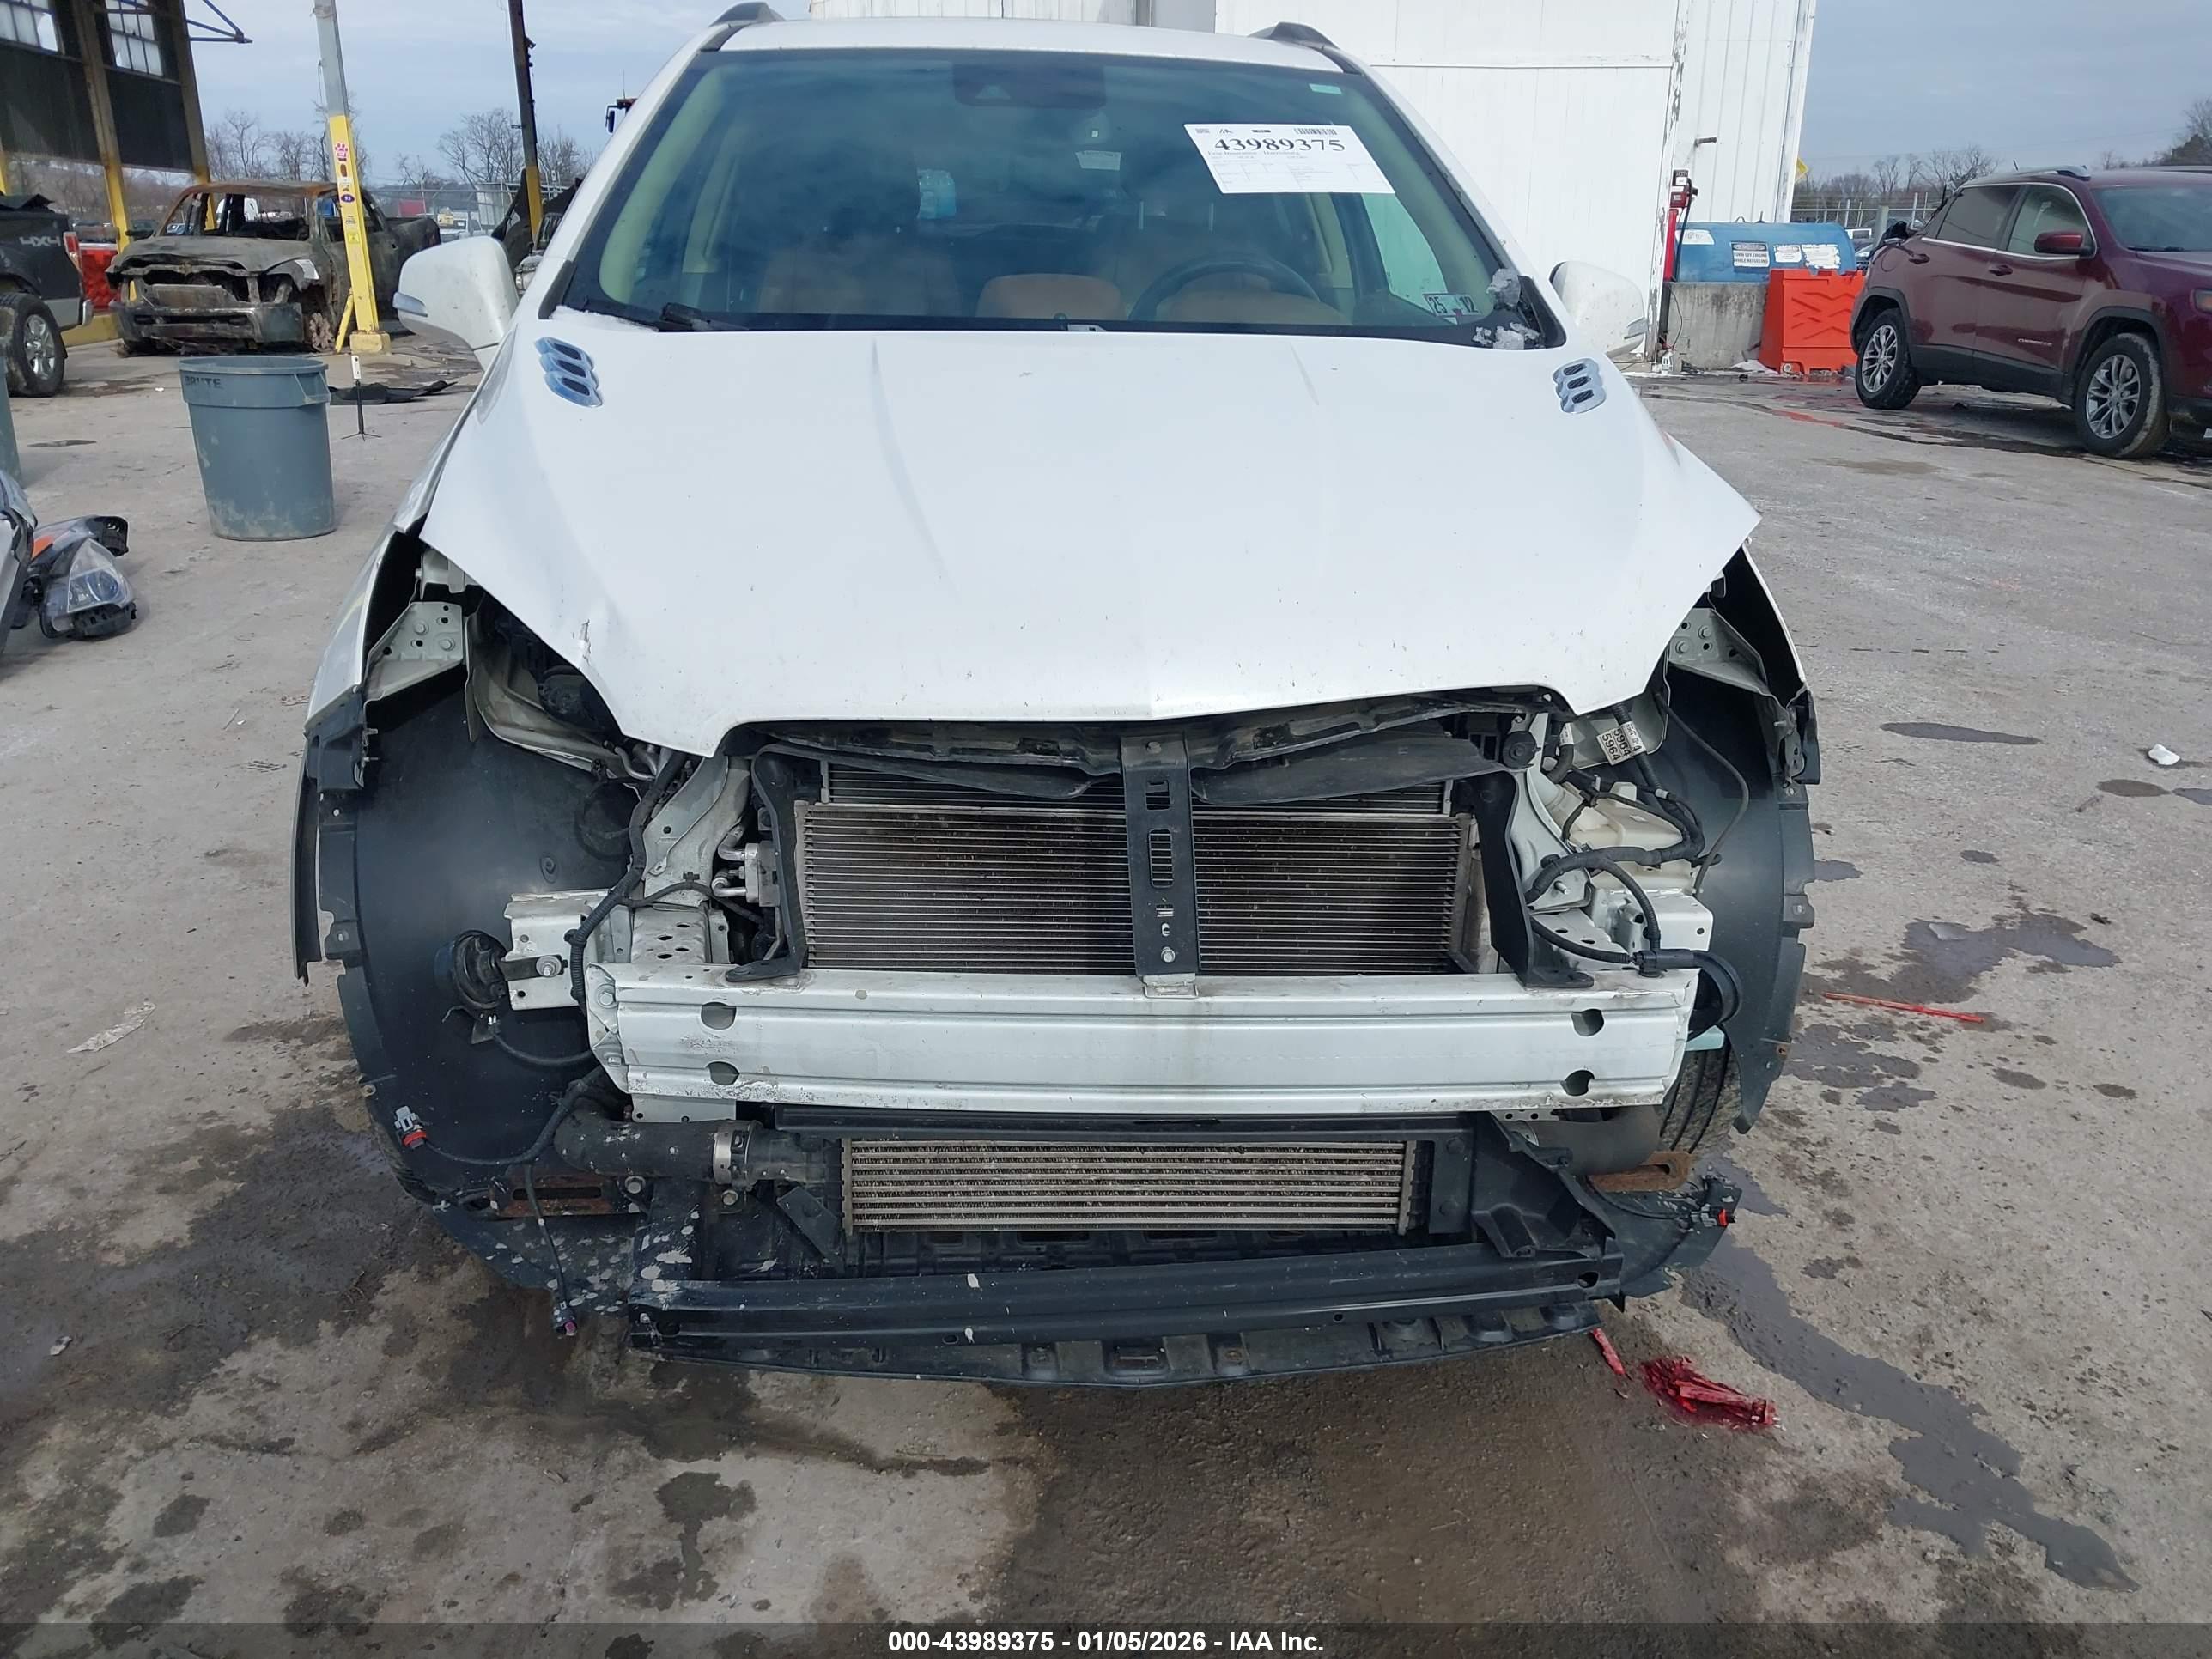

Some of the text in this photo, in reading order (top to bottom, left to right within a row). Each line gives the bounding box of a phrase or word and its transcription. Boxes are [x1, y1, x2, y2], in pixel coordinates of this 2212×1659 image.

[1214, 137, 1346, 152] 43989375
[1428, 295, 1479, 313] 25 12
[185, 375, 222, 389] BRUTE
[1602, 733, 1621, 760] 5964
[1613, 728, 1631, 756] 5964
